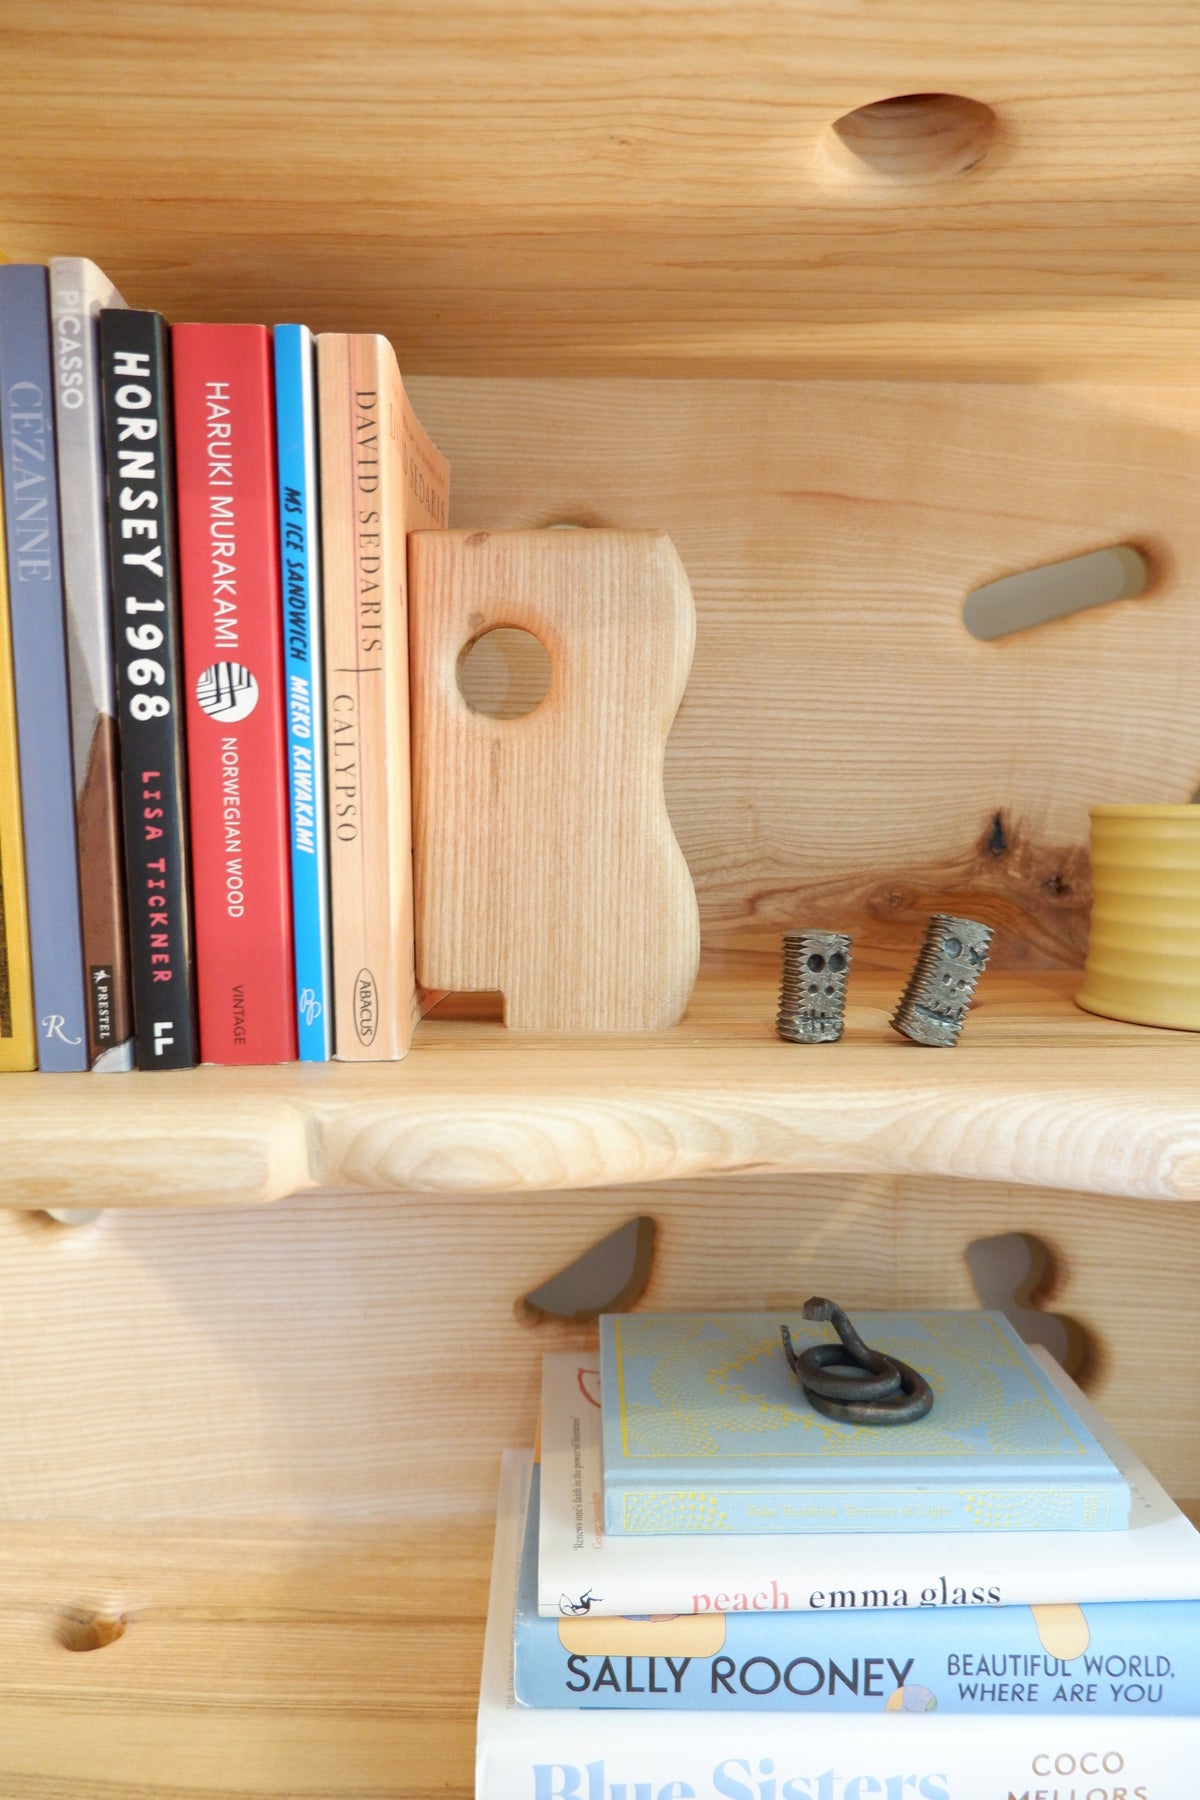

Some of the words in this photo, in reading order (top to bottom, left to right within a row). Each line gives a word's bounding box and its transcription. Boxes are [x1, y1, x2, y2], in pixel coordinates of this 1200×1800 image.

[57, 290, 84, 410] PICASSO
[113, 351, 164, 578] HORNSEY
[205, 382, 234, 486] HARUKI
[355, 390, 380, 494] DAVID
[7, 381, 53, 583] CÉZANNE
[284, 486, 302, 517] MS
[409, 457, 446, 529] SEDARIS
[285, 523, 304, 551] ICE
[210, 497, 239, 649] MURAKAMI
[358, 510, 383, 653] SEDARIS
[287, 557, 308, 662] SANDWICH
[125, 597, 170, 722] 1968
[289, 675, 312, 739] MIEKO
[220, 737, 242, 853] NORWEGIAN
[291, 744, 315, 854] KAWAKAMI
[332, 693, 359, 842] CALYPSO
[141, 770, 163, 841] LISA
[146, 858, 173, 983] TICKNER
[225, 858, 244, 918] WOOD
[41, 1014, 82, 1045] R
[97, 985, 111, 1039] PRESTEL
[232, 984, 247, 1045] VINTAGE
[359, 979, 373, 1037] ABACUS
[571, 1487, 582, 1503] faith
[692, 1579, 790, 1614] peach
[808, 1587, 909, 1609] emma
[919, 1575, 1002, 1609] glass
[565, 1653, 692, 1694] SALLY
[710, 1654, 915, 1697] ROONEY
[947, 1653, 1072, 1678] BEAUTIFUL
[958, 1683, 1039, 1702] WHERE
[1052, 1683, 1098, 1702] ARE
[1110, 1684, 1164, 1703] YOU
[1031, 1751, 1125, 1777] COCO
